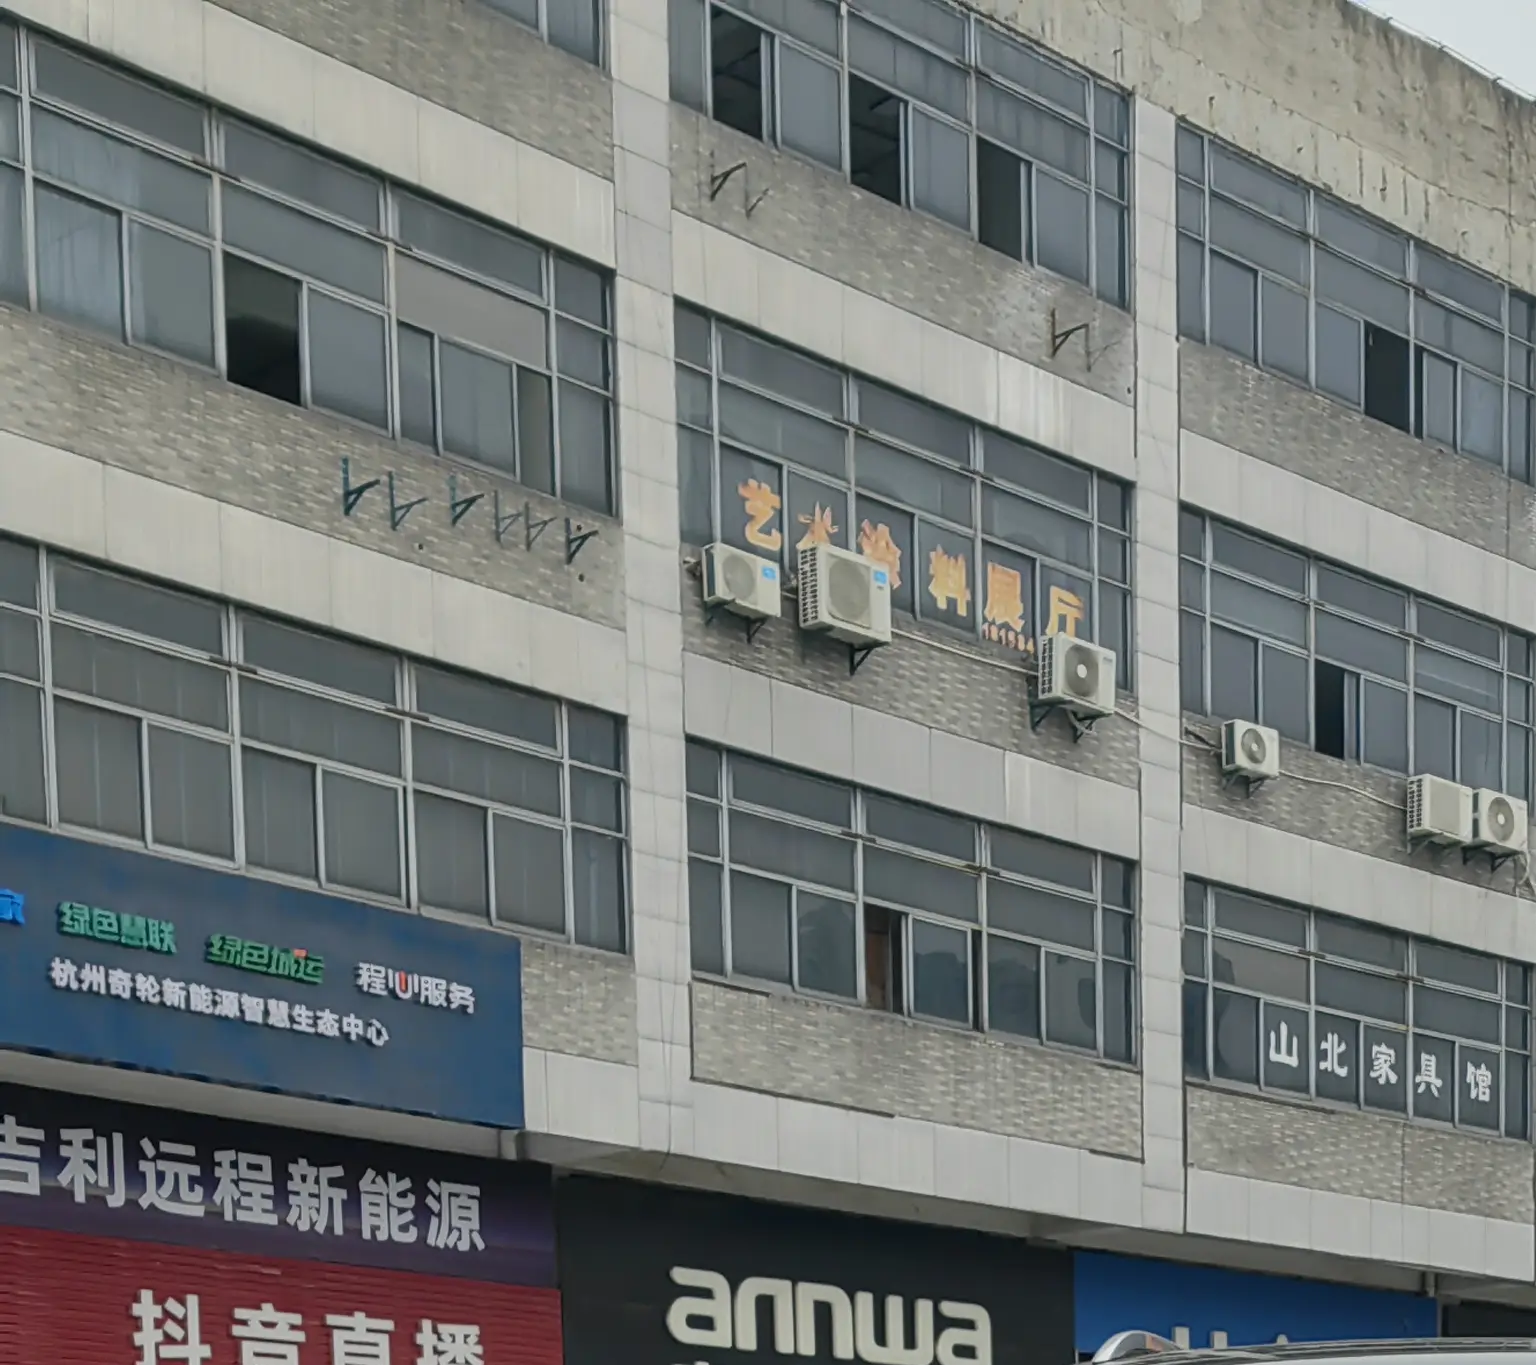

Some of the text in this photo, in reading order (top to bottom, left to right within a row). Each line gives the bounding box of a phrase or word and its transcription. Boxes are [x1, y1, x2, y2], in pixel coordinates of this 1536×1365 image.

[50, 956, 389, 1047] 杭州奇轮新能源智慧生态中心
[1268, 1020, 1493, 1103] 山北家具馆
[0, 1115, 485, 1252] 吉利远程新能源
